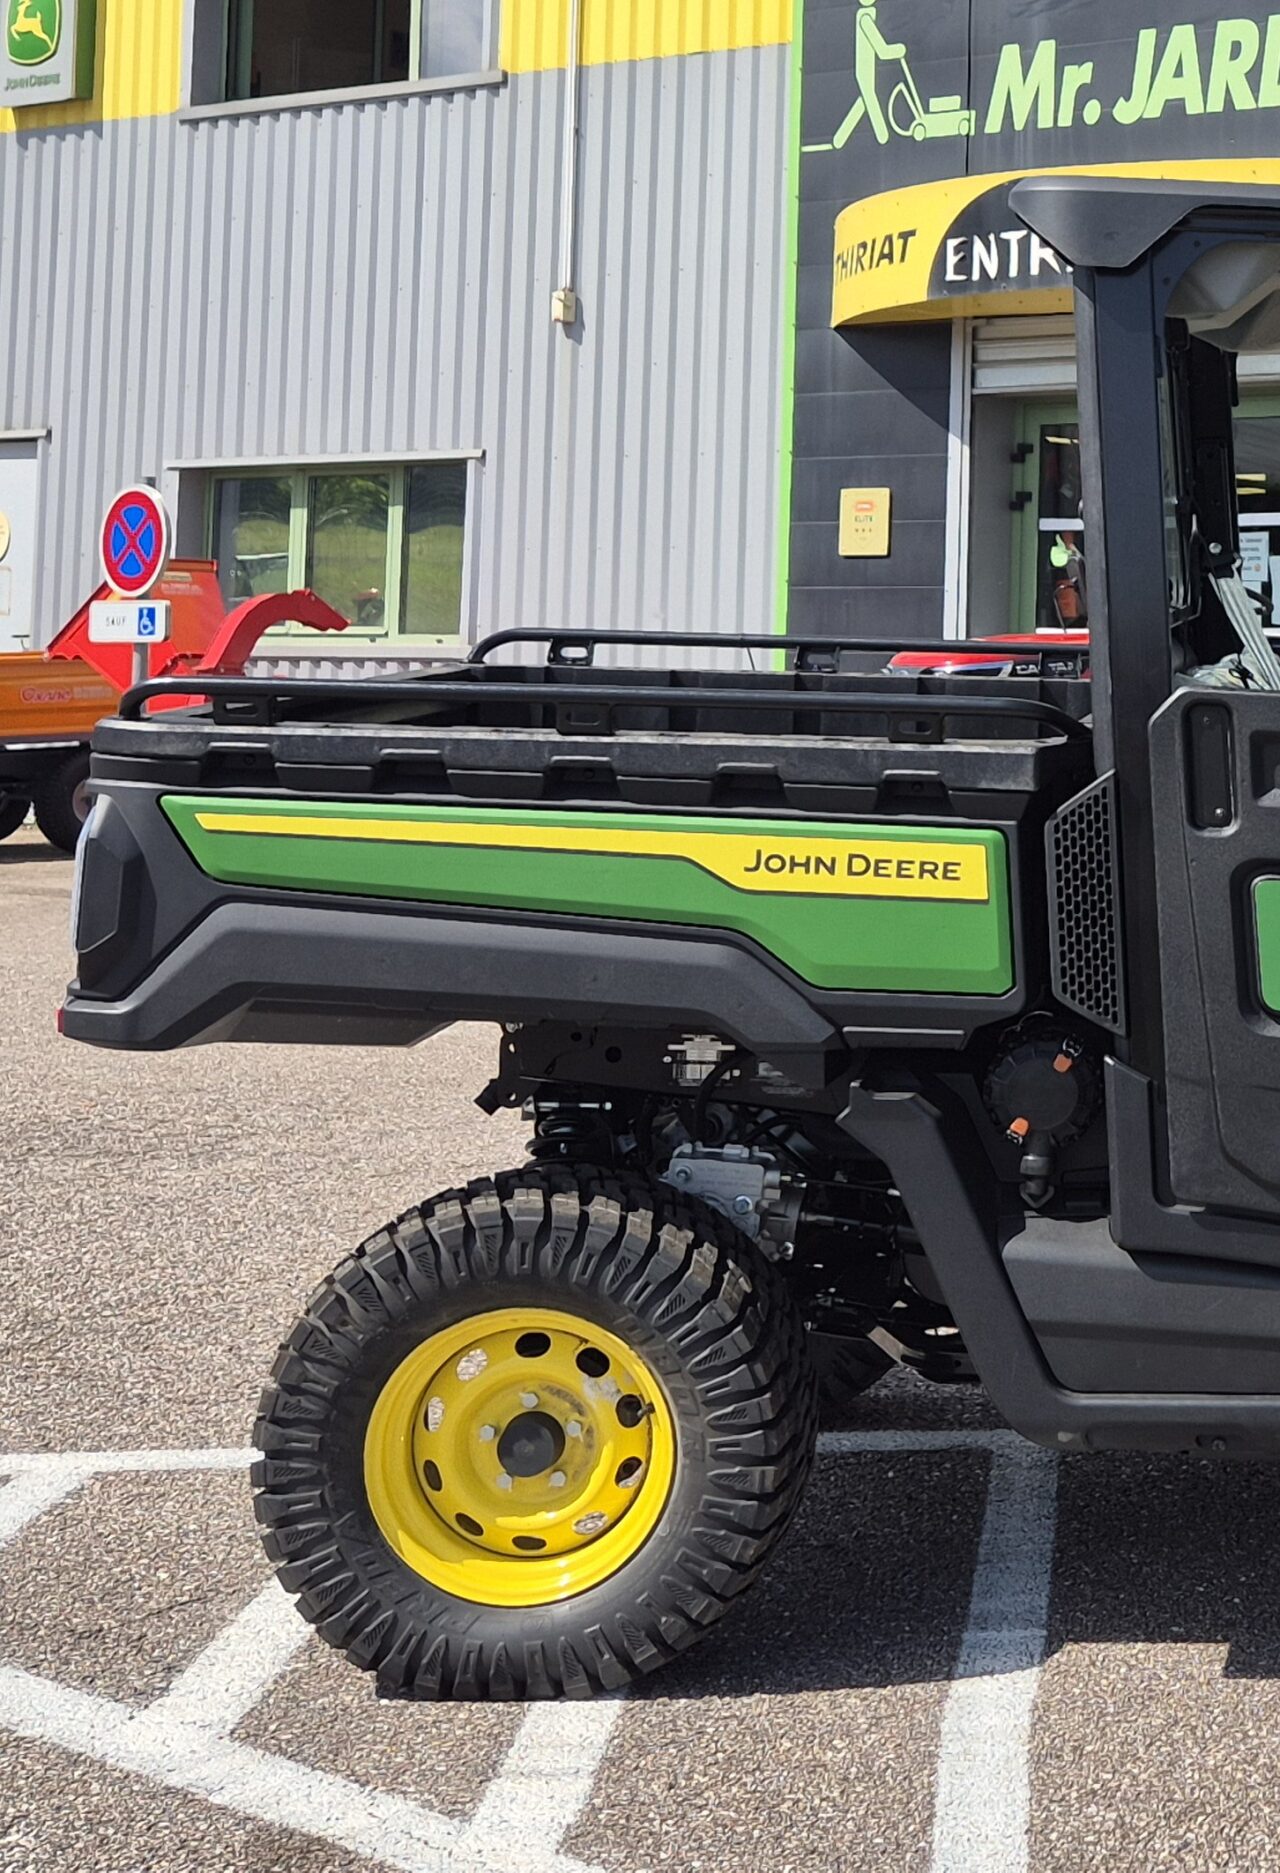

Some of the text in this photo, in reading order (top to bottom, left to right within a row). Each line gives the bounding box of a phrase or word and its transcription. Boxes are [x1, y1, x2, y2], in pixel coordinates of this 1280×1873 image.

[984, 39, 1101, 134] Mr.
[836, 229, 917, 285] THIRIAT
[945, 229, 1074, 282] ENTR
[744, 849, 961, 881] JOHN DEERE
